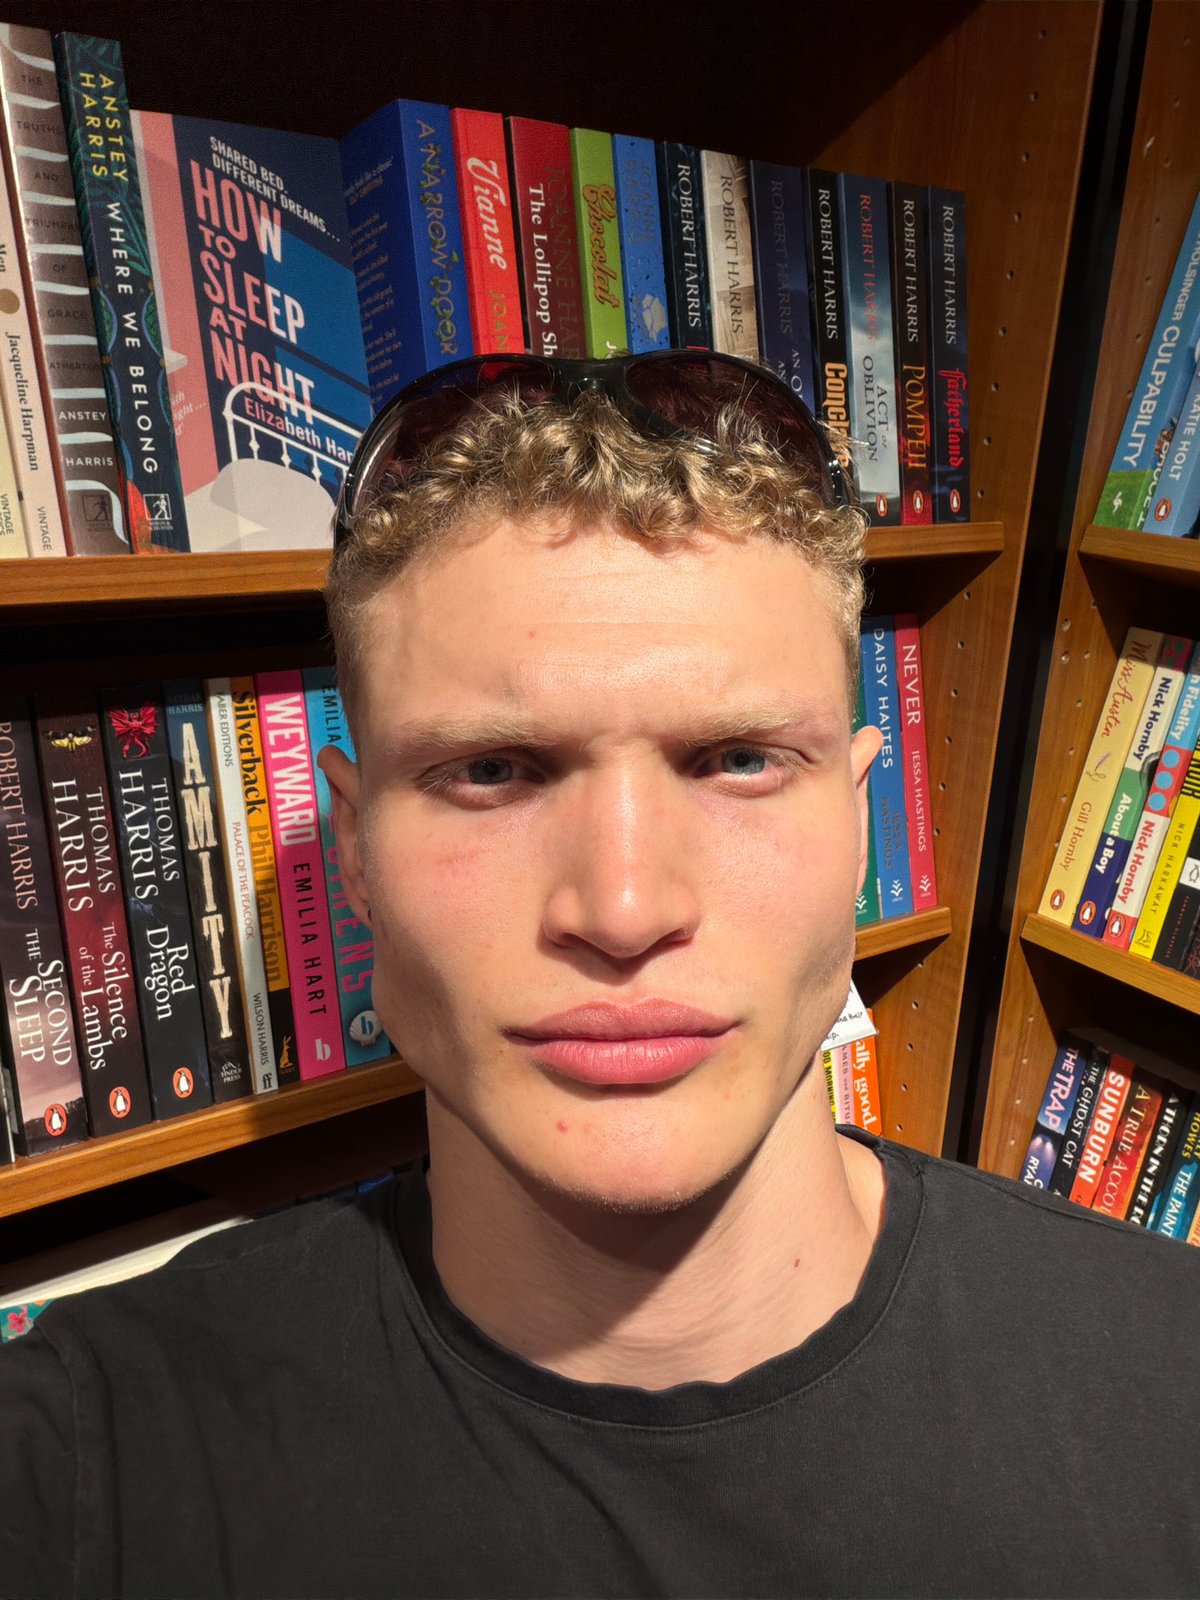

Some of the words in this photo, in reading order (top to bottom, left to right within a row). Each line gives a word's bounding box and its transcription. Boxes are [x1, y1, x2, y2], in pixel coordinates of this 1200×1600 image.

[79, 72, 109, 178] HARRIS
[98, 73, 129, 183] ANSTEY
[416, 118, 436, 139] A
[209, 135, 258, 175] SHARED
[260, 165, 289, 194] BED.
[212, 152, 278, 204] DIFFERENT
[190, 159, 282, 263] HOW
[466, 156, 508, 271] Vianne
[529, 182, 545, 226] The
[677, 163, 696, 249] ROBERT
[720, 175, 738, 256] ROBERT
[771, 180, 787, 259] ROBERT
[818, 189, 834, 266] ROBERT
[859, 194, 875, 270] ROBERT
[105, 201, 134, 295] WHERE
[198, 224, 236, 259] TO
[582, 184, 621, 309] Chocolat
[903, 199, 916, 272] ROBERT
[943, 205, 955, 276] ROBERT
[199, 250, 305, 344] SLEEP
[532, 232, 552, 324] Lollipop
[684, 251, 701, 328] HARRIS
[727, 260, 744, 334] HARRIS
[776, 262, 792, 335] HARRIS
[823, 270, 838, 339] HARRIS
[864, 273, 878, 340] HARRIS
[121, 311, 141, 348] WE
[209, 306, 247, 341] AT
[906, 276, 918, 343] HARRIS
[944, 281, 957, 345] HARRIS
[210, 329, 315, 425] NIGHT
[791, 348, 800, 368] AN
[5, 332, 28, 405] Jacqueline
[21, 407, 39, 471] Harpman
[59, 411, 107, 421] ANSTEY
[128, 365, 159, 474] BELONG
[244, 396, 321, 450] Elizabeth
[862, 356, 879, 462] OBLIVION
[877, 386, 889, 431] ACT
[903, 364, 927, 469] POMPEII
[1124, 325, 1181, 467] CULPABILITY
[66, 457, 114, 467] HARRIS
[1168, 441, 1191, 481] HOLT
[38, 505, 52, 551] VINTAGE
[874, 628, 888, 687] DAISY
[1120, 640, 1152, 682] Miss
[167, 703, 204, 715] HARRIS
[321, 684, 342, 743] EMILIA
[1101, 683, 1134, 739] Austen
[1151, 676, 1172, 712] Nick
[1170, 686, 1200, 741] Fidelity
[219, 721, 234, 767] EDITIONS
[878, 697, 894, 769] HAITES
[903, 645, 921, 725] NEVER
[914, 788, 927, 852] HASTINGS
[1133, 711, 1161, 761] Hornby
[0, 721, 25, 815] ROBERT
[264, 694, 317, 847] WEYWARD
[86, 786, 116, 894] THOMAS
[119, 768, 159, 900] HARRIS
[151, 777, 180, 882] THOMAS
[232, 690, 267, 815] Silverback
[255, 877, 282, 982] Harrison
[232, 822, 246, 857] PALACE
[1077, 801, 1092, 824] Gill
[1108, 793, 1133, 837] About
[1138, 820, 1156, 853] Nick
[1171, 822, 1186, 849] NICK
[6, 821, 39, 910] HARRIS
[52, 776, 94, 912] HARRIS
[238, 859, 248, 872] OF
[1059, 826, 1085, 872] Hornby
[1095, 847, 1115, 875] Boy
[1105, 838, 1116, 847] a
[180, 722, 233, 1039] AMITY
[240, 874, 250, 892] THE
[294, 862, 318, 944] EMILIA
[1117, 853, 1145, 904] Hornby
[1151, 855, 1176, 915] HARKAWAY
[102, 922, 115, 949] The
[242, 893, 256, 940] PEACOCK
[78, 946, 94, 962] of
[81, 964, 96, 986] the
[145, 925, 173, 1020] Dragon
[166, 943, 196, 995] Red
[25, 928, 42, 961] THE
[37, 960, 73, 1066] SECOND
[101, 950, 130, 1040] Silence
[253, 993, 267, 1027] WILSON
[304, 956, 327, 1015] HART
[9, 975, 46, 1063] SLEEP
[80, 987, 114, 1071] Lambs
[257, 1027, 270, 1065] HARRIS
[1062, 1049, 1079, 1073] THE
[1088, 1066, 1099, 1084] THE
[1044, 1072, 1074, 1130] TRAP
[1074, 1087, 1094, 1138] GHOST
[1135, 1084, 1150, 1101] A
[1167, 1092, 1180, 1104] A
[1061, 1140, 1078, 1169] CAT
[1080, 1071, 1125, 1184] SUNBURN
[1119, 1105, 1147, 1156] TRUE
[1150, 1106, 1177, 1157] THORN
[1138, 1178, 1154, 1206] THE
[1146, 1157, 1161, 1176] IN
[1173, 1170, 1192, 1198] THE
